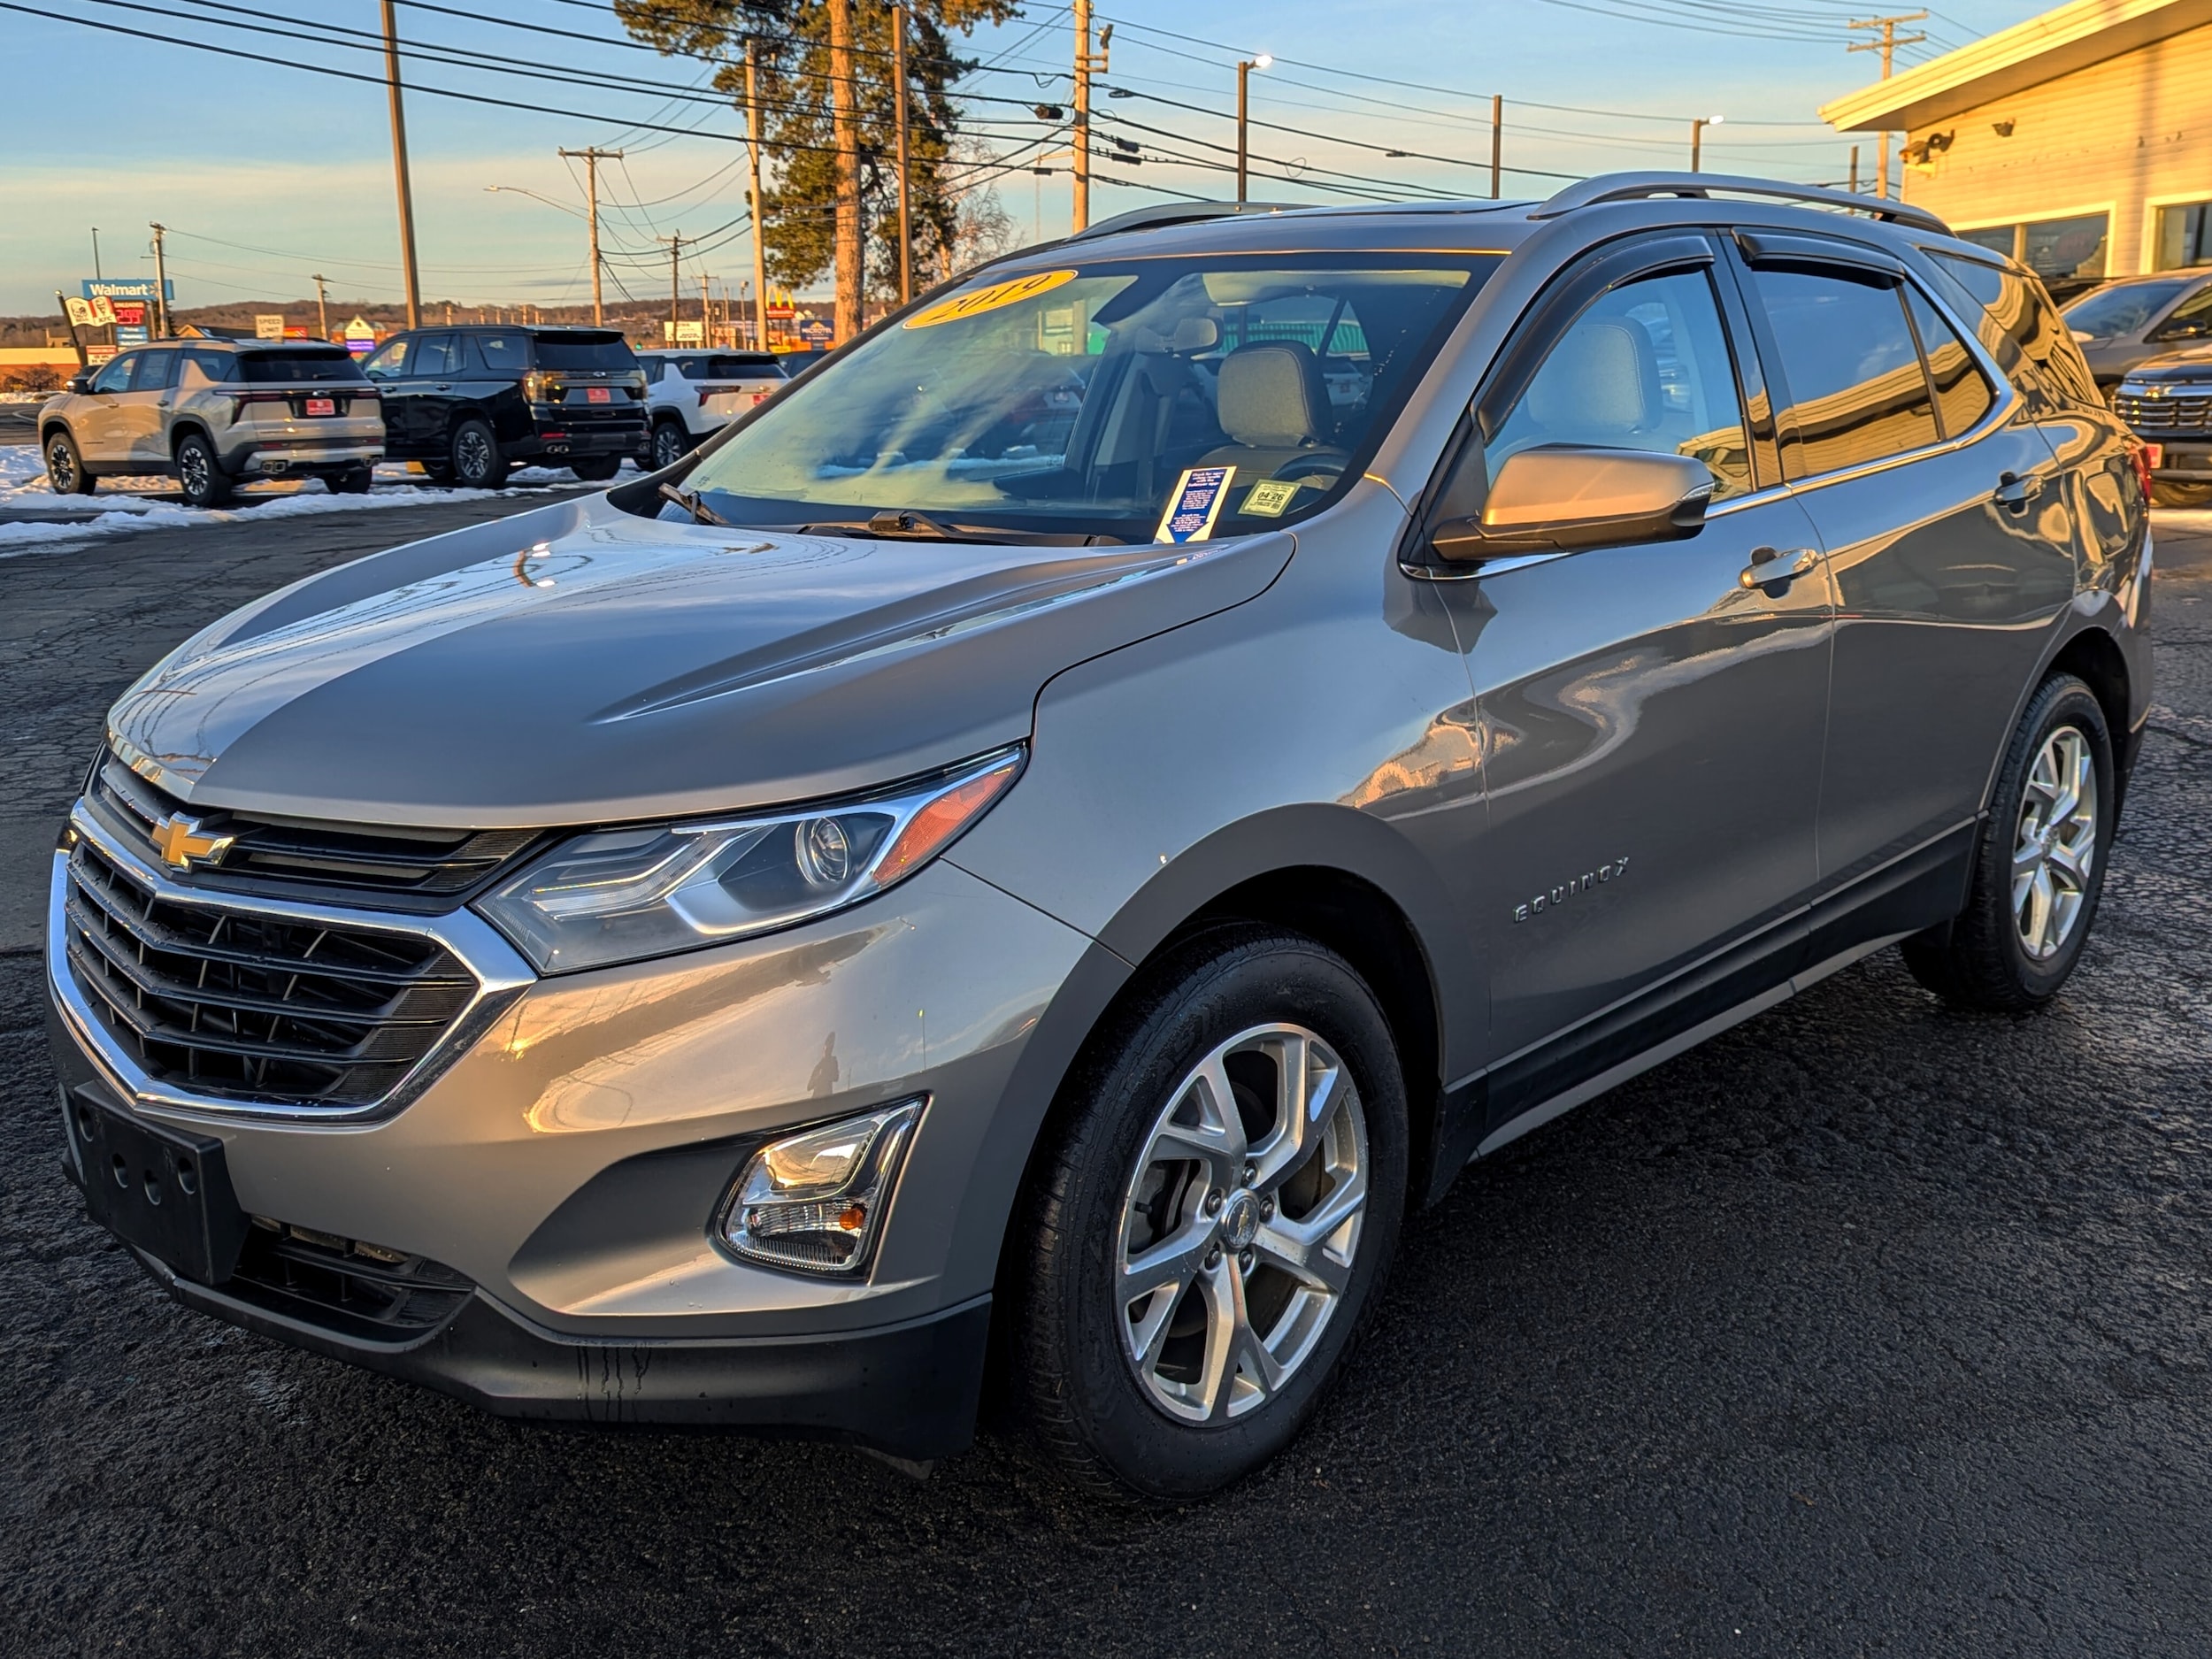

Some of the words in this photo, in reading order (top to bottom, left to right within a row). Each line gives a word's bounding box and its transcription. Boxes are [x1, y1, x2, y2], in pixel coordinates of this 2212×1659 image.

[89, 284, 149, 296] Walmart
[927, 275, 1052, 322] 2019
[1513, 856, 1629, 923] EQUINOX
